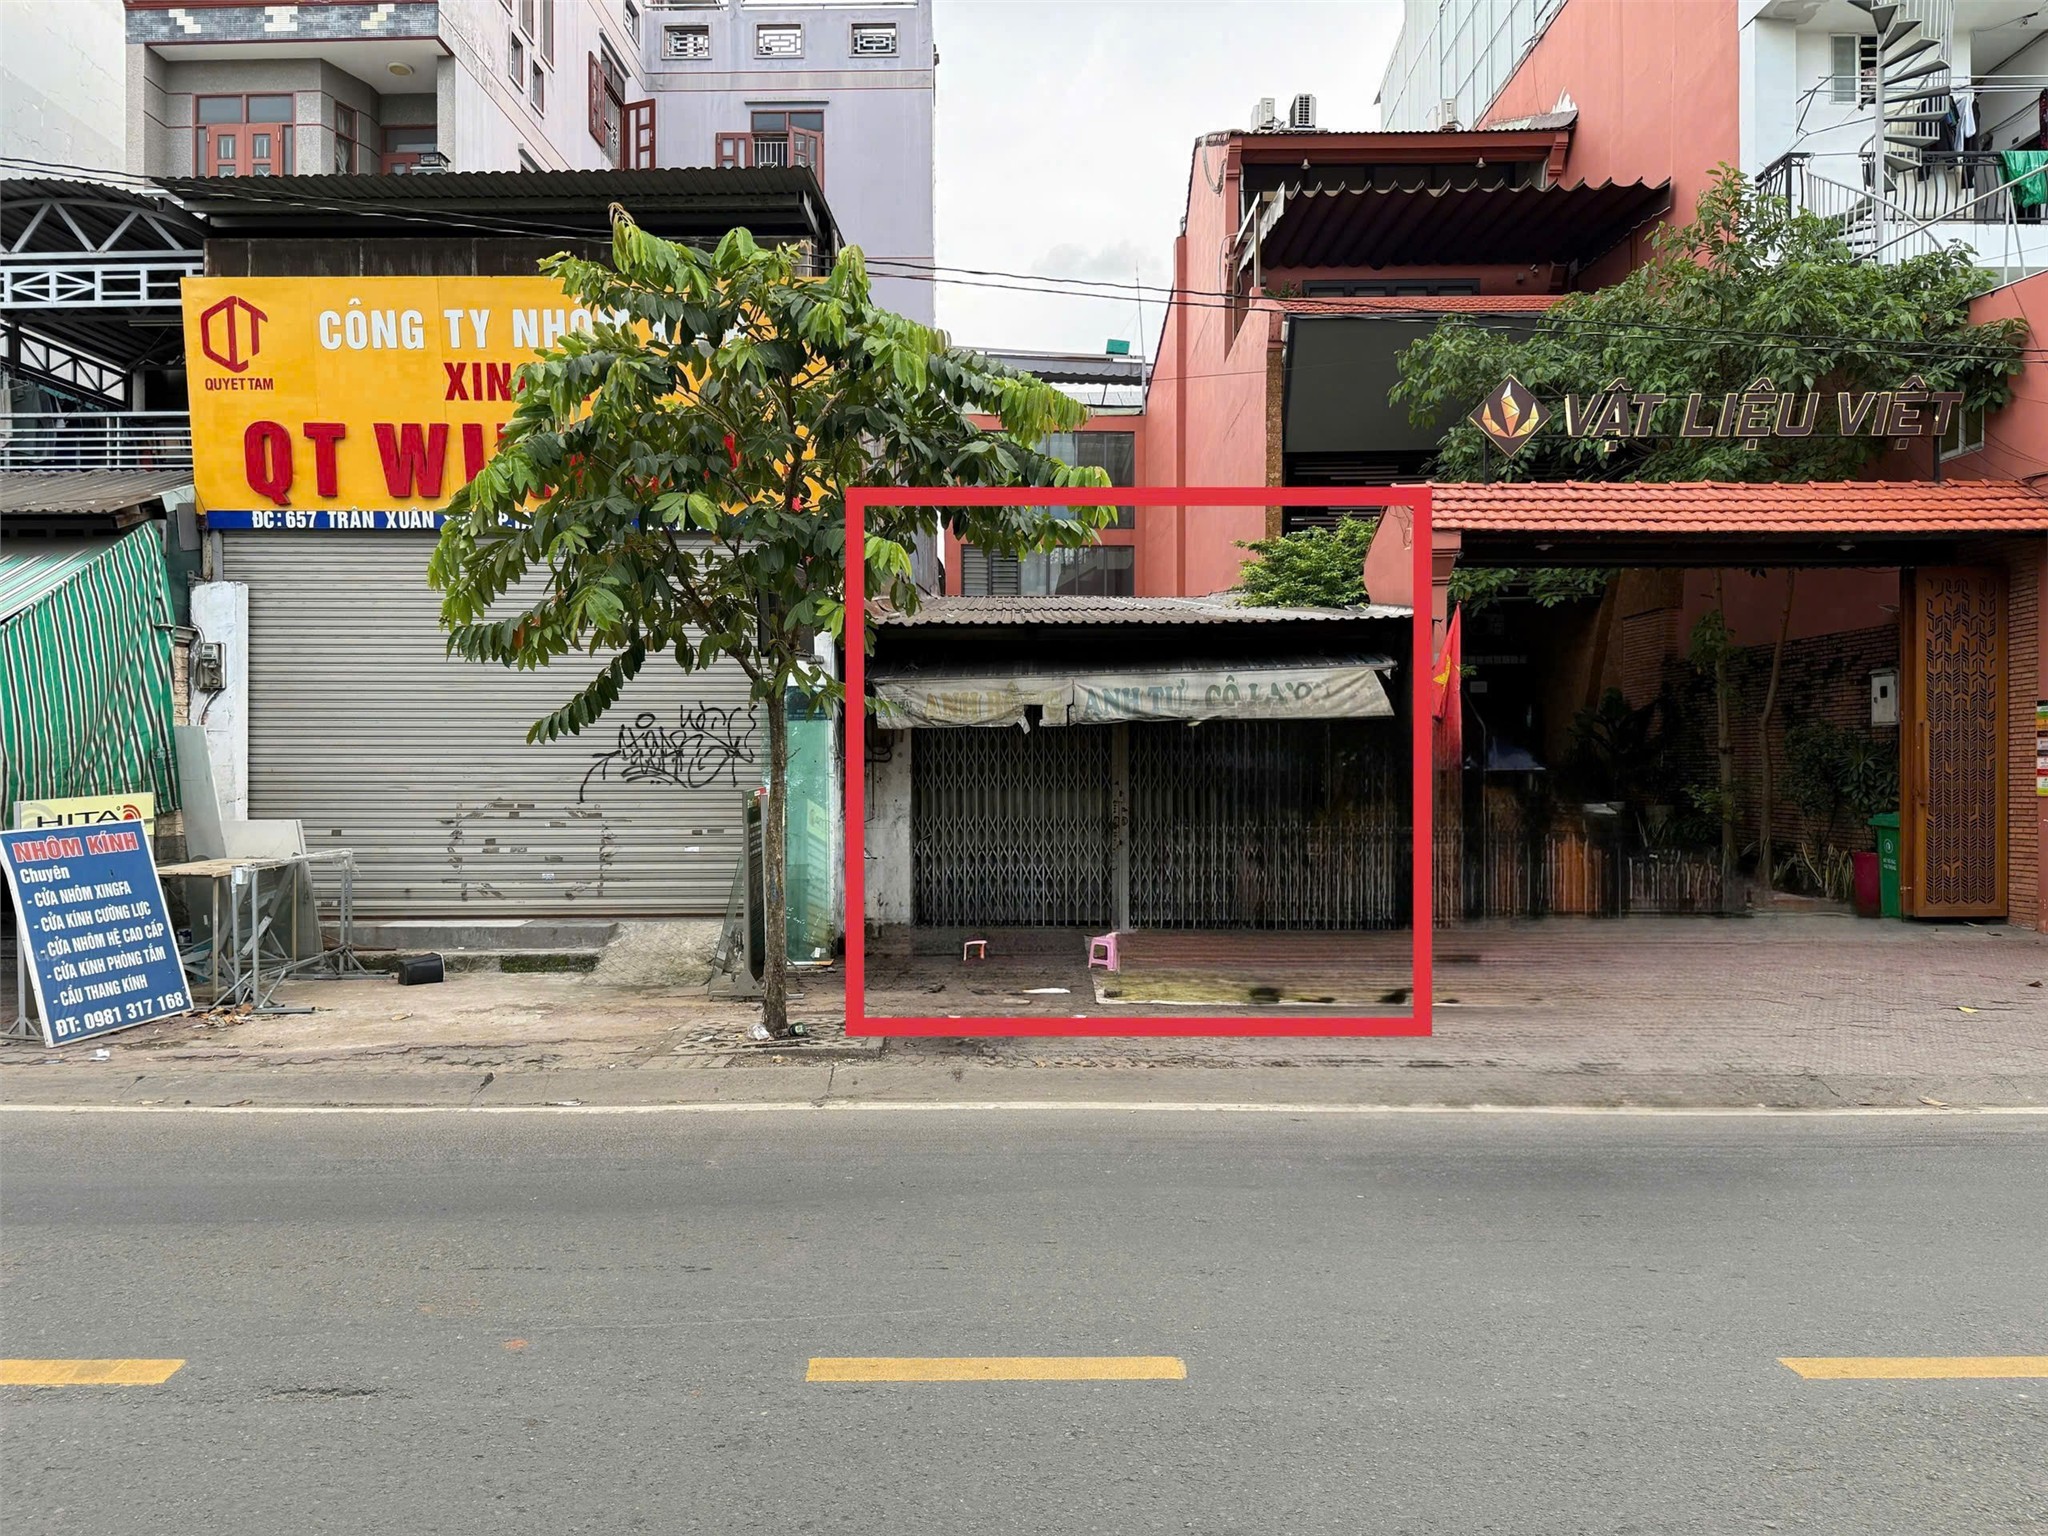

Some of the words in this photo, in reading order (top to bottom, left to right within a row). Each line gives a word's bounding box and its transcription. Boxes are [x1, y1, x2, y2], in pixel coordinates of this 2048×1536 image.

[318, 297, 425, 350] CÔNG
[444, 309, 491, 349] TY
[1564, 377, 1666, 452] VẬT
[1681, 377, 1819, 450] LIỆU
[1838, 375, 1964, 450] VIỆT
[244, 420, 346, 506] QT
[385, 506, 435, 529] XUÂN
[1083, 687, 1140, 718] ANH
[37, 810, 119, 828] HITA
[12, 835, 84, 863] NHÔM
[85, 830, 139, 856] KÍNH
[20, 865, 70, 884] Chuyên
[34, 887, 59, 907] CỬA
[59, 884, 94, 904] NHÔM
[94, 881, 132, 899] XINGFA
[40, 911, 66, 932] CỬA
[65, 909, 94, 928] KÍNH
[94, 903, 131, 924] CƯỜNG
[131, 901, 152, 919] LỰC
[47, 936, 72, 957] CỬA
[72, 932, 106, 953] NHÔM
[106, 928, 122, 948] HỆ
[122, 927, 144, 944] CAO
[144, 918, 165, 939] CẤP
[53, 960, 78, 982] CỬA
[78, 957, 106, 977] KÍNH
[107, 951, 143, 970] PHÒNG
[143, 943, 167, 963] TẮM
[84, 980, 121, 1001] THANG
[122, 974, 148, 993] KÍNH
[56, 1016, 82, 1037] ĐT:
[84, 1007, 122, 1029] 0981
[127, 998, 153, 1020] 317
[156, 991, 185, 1011] 168
